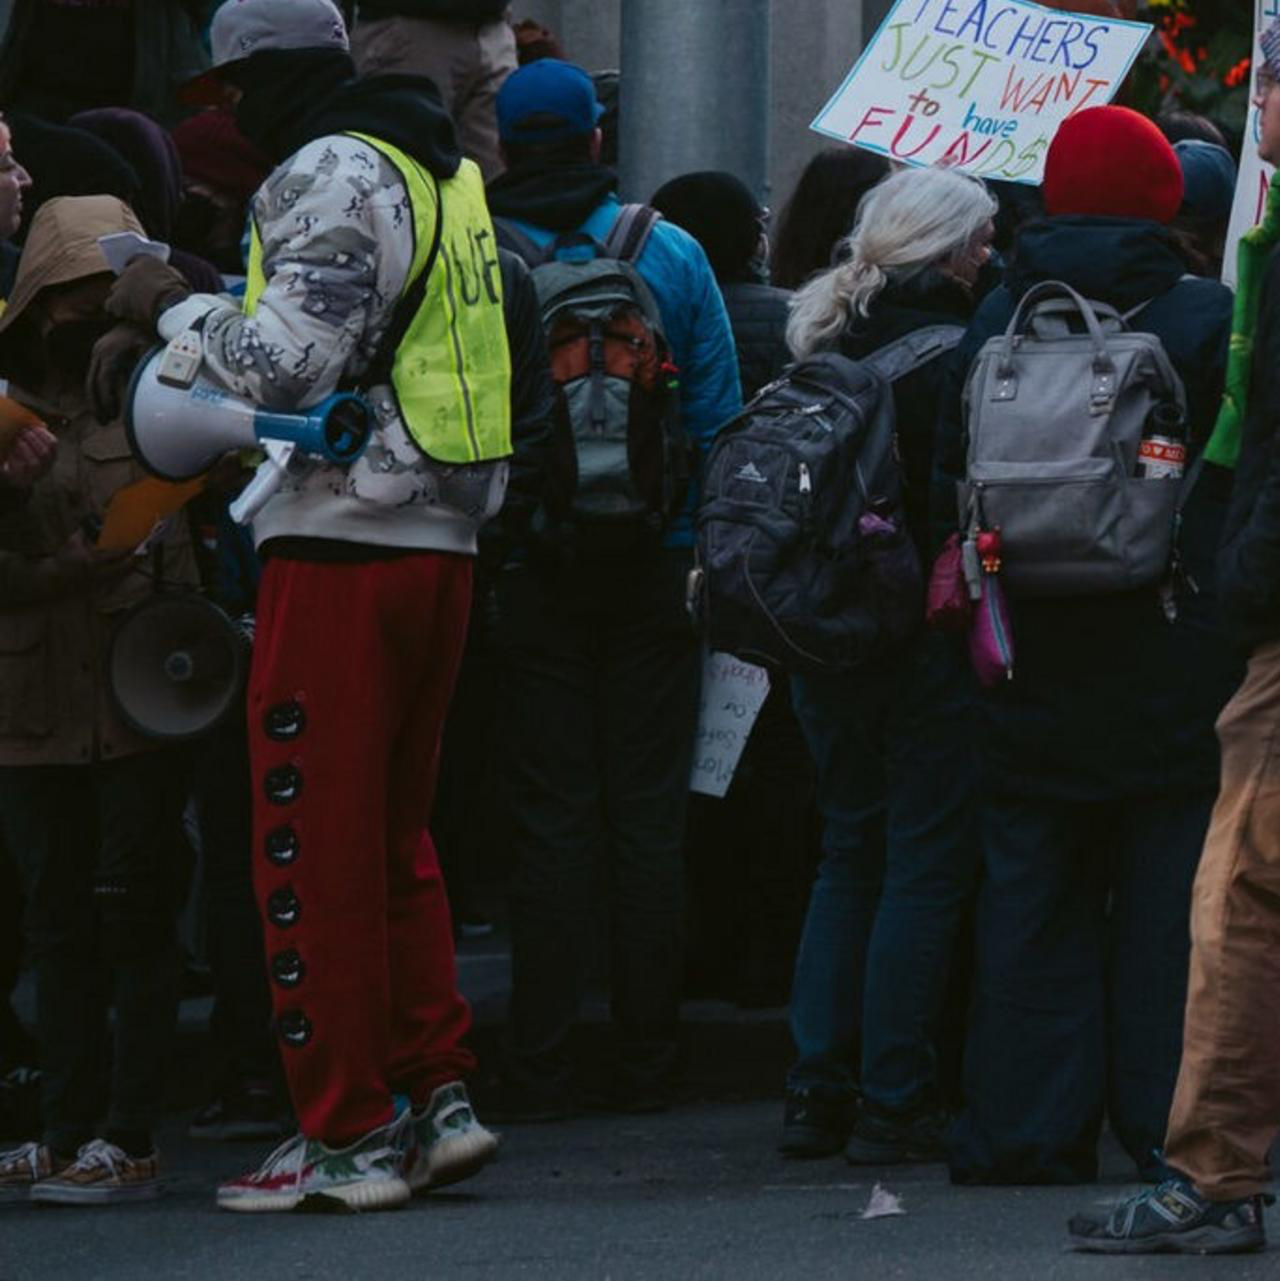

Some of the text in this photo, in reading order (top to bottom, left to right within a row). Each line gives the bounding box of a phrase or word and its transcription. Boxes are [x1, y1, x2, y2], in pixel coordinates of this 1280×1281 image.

[881, 22, 1110, 116] JUST WANT
[908, 88, 1019, 138] to have
